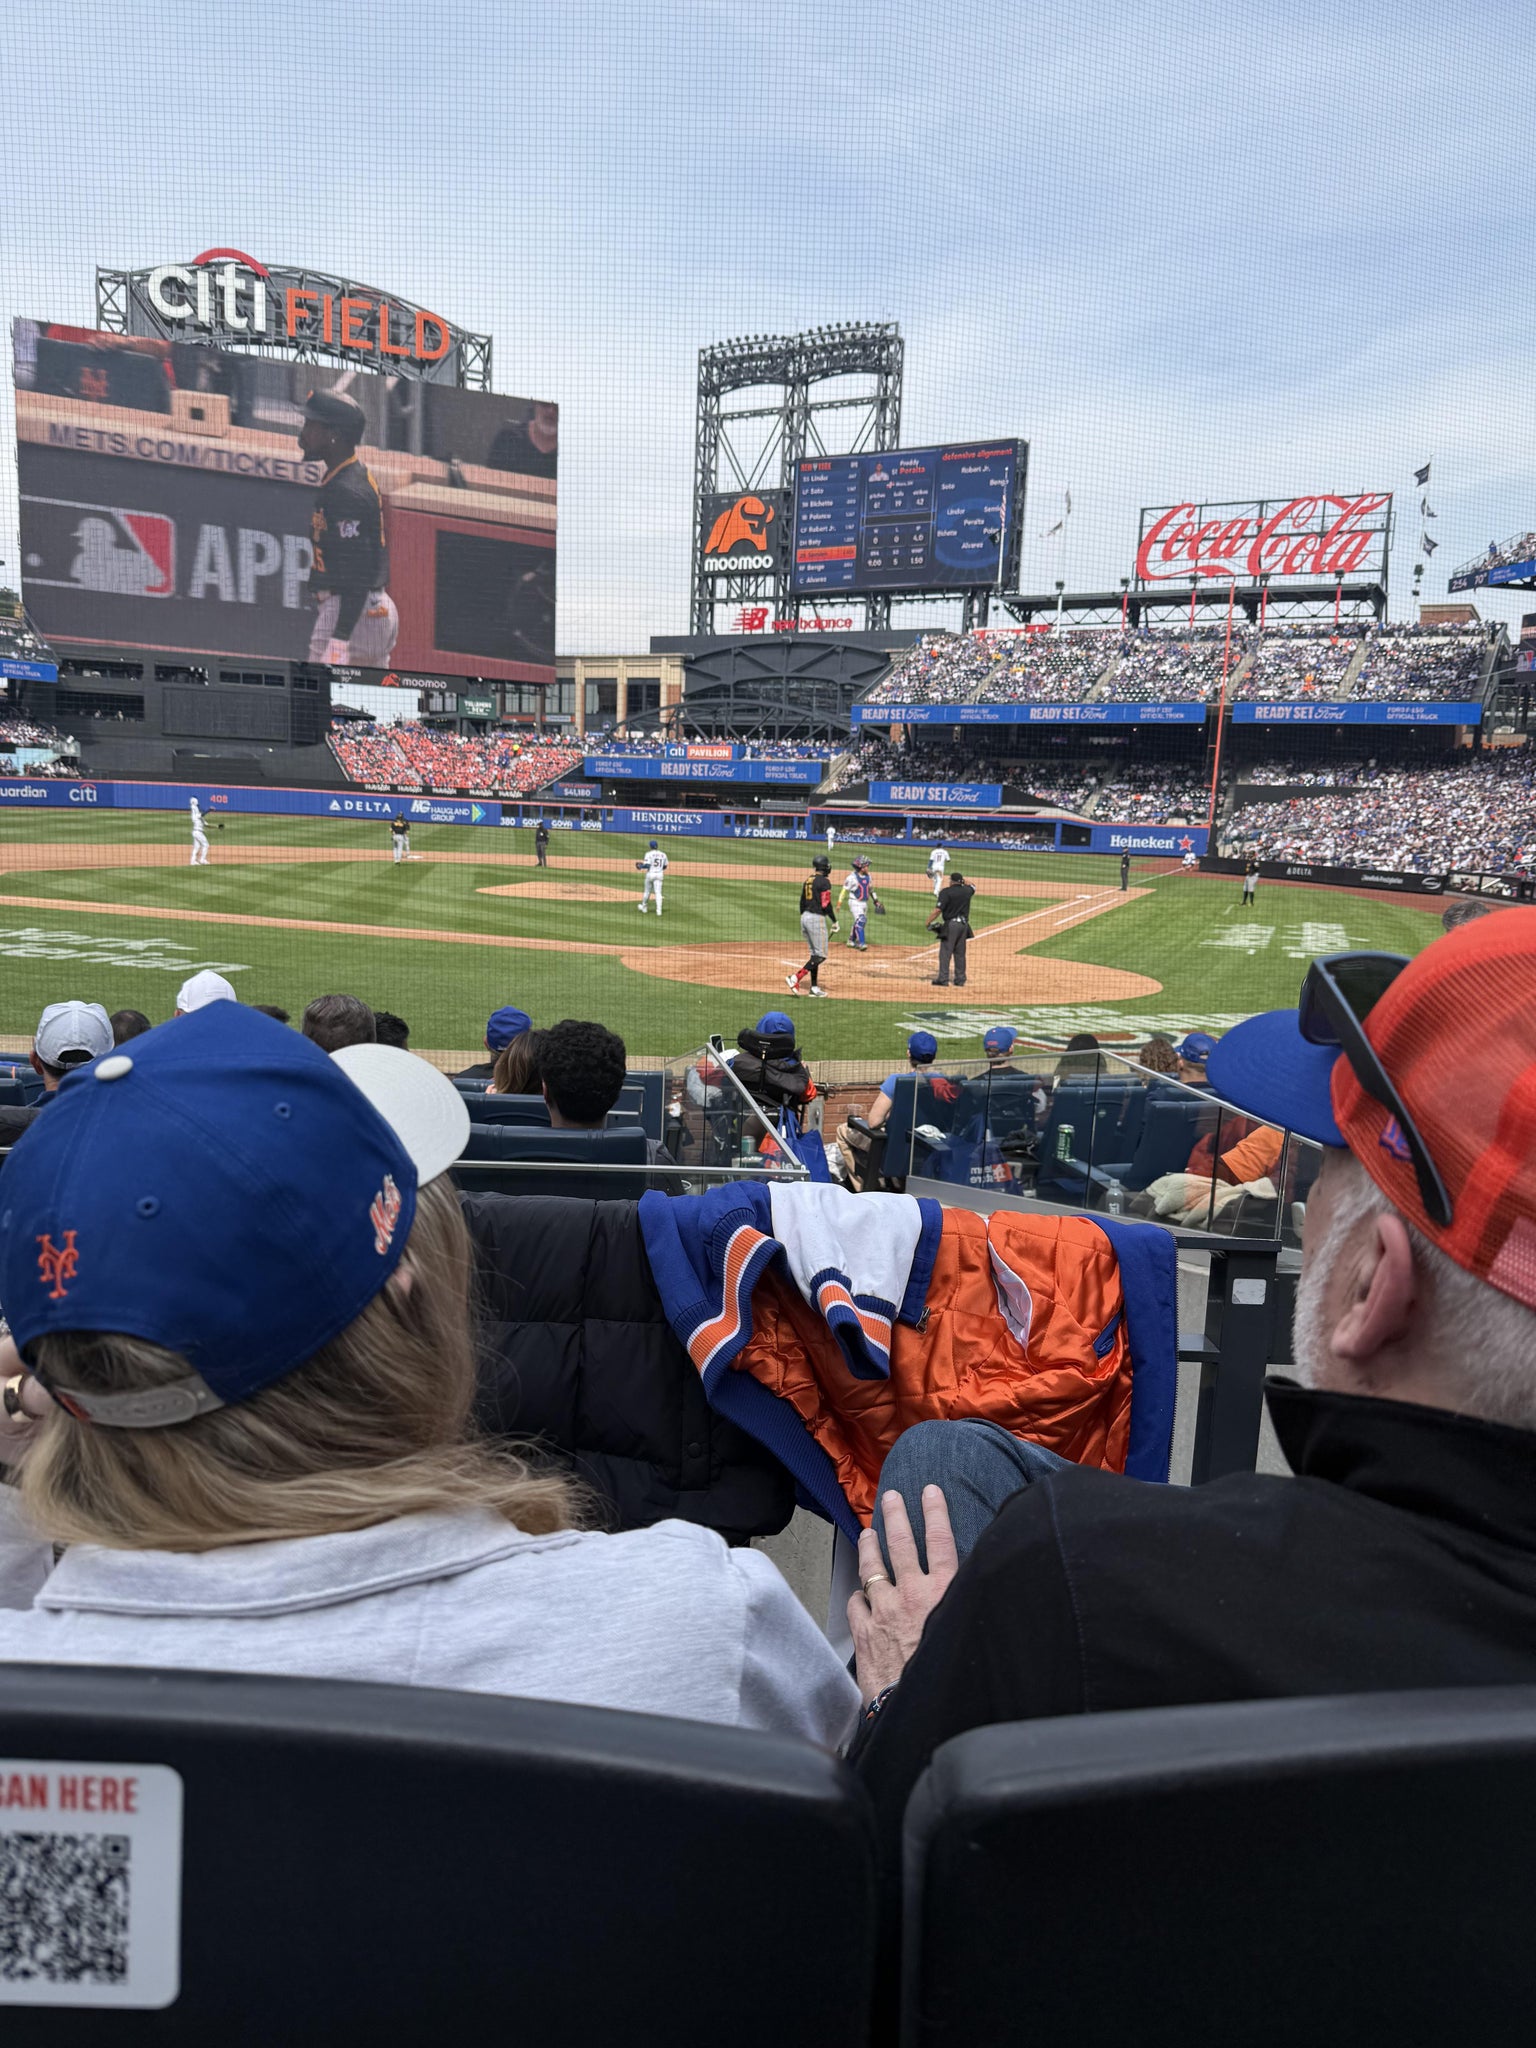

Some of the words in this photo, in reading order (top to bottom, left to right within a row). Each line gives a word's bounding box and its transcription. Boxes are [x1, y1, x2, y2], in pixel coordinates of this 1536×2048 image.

[148, 262, 267, 333] citi
[286, 287, 450, 360] FIELD
[50, 423, 322, 484] METS.COM/TICKETS
[942, 452, 976, 461] defensive
[977, 448, 1012, 459] alignment
[1136, 492, 1393, 580] Coca-Cola
[190, 524, 314, 609] APP
[704, 554, 774, 571] moomoo
[800, 616, 853, 631] balance
[402, 677, 448, 689] moomoo
[862, 708, 889, 720] READY
[890, 708, 906, 719] SET
[906, 708, 929, 720] Ford
[1030, 707, 1061, 719] READY
[1063, 707, 1080, 719] SET
[1080, 707, 1108, 720] Ford
[1255, 706, 1292, 719] READY
[1293, 706, 1314, 719] SET
[1314, 706, 1347, 720] Ford
[669, 745, 685, 757] citi
[690, 748, 729, 758] PAVILION
[661, 762, 690, 776] READY
[692, 763, 709, 776] SET
[709, 764, 735, 777] Ford
[0, 782, 47, 799] uardian
[69, 785, 97, 803] citi
[210, 794, 228, 804] 408
[890, 785, 925, 800] READY
[928, 786, 948, 801] SET
[948, 787, 980, 802] Ford
[344, 799, 391, 813] DELTA
[430, 814, 455, 822] GROUP
[632, 811, 702, 825] HENDRICK'S
[657, 824, 678, 832] GIN
[753, 829, 788, 839] DUNKIN'
[795, 830, 807, 839] 370
[1002, 843, 1056, 852] CADILLAC
[1110, 834, 1175, 849] Heineken
[653, 858, 662, 868] 51
[59, 1774, 140, 1814] HERE
